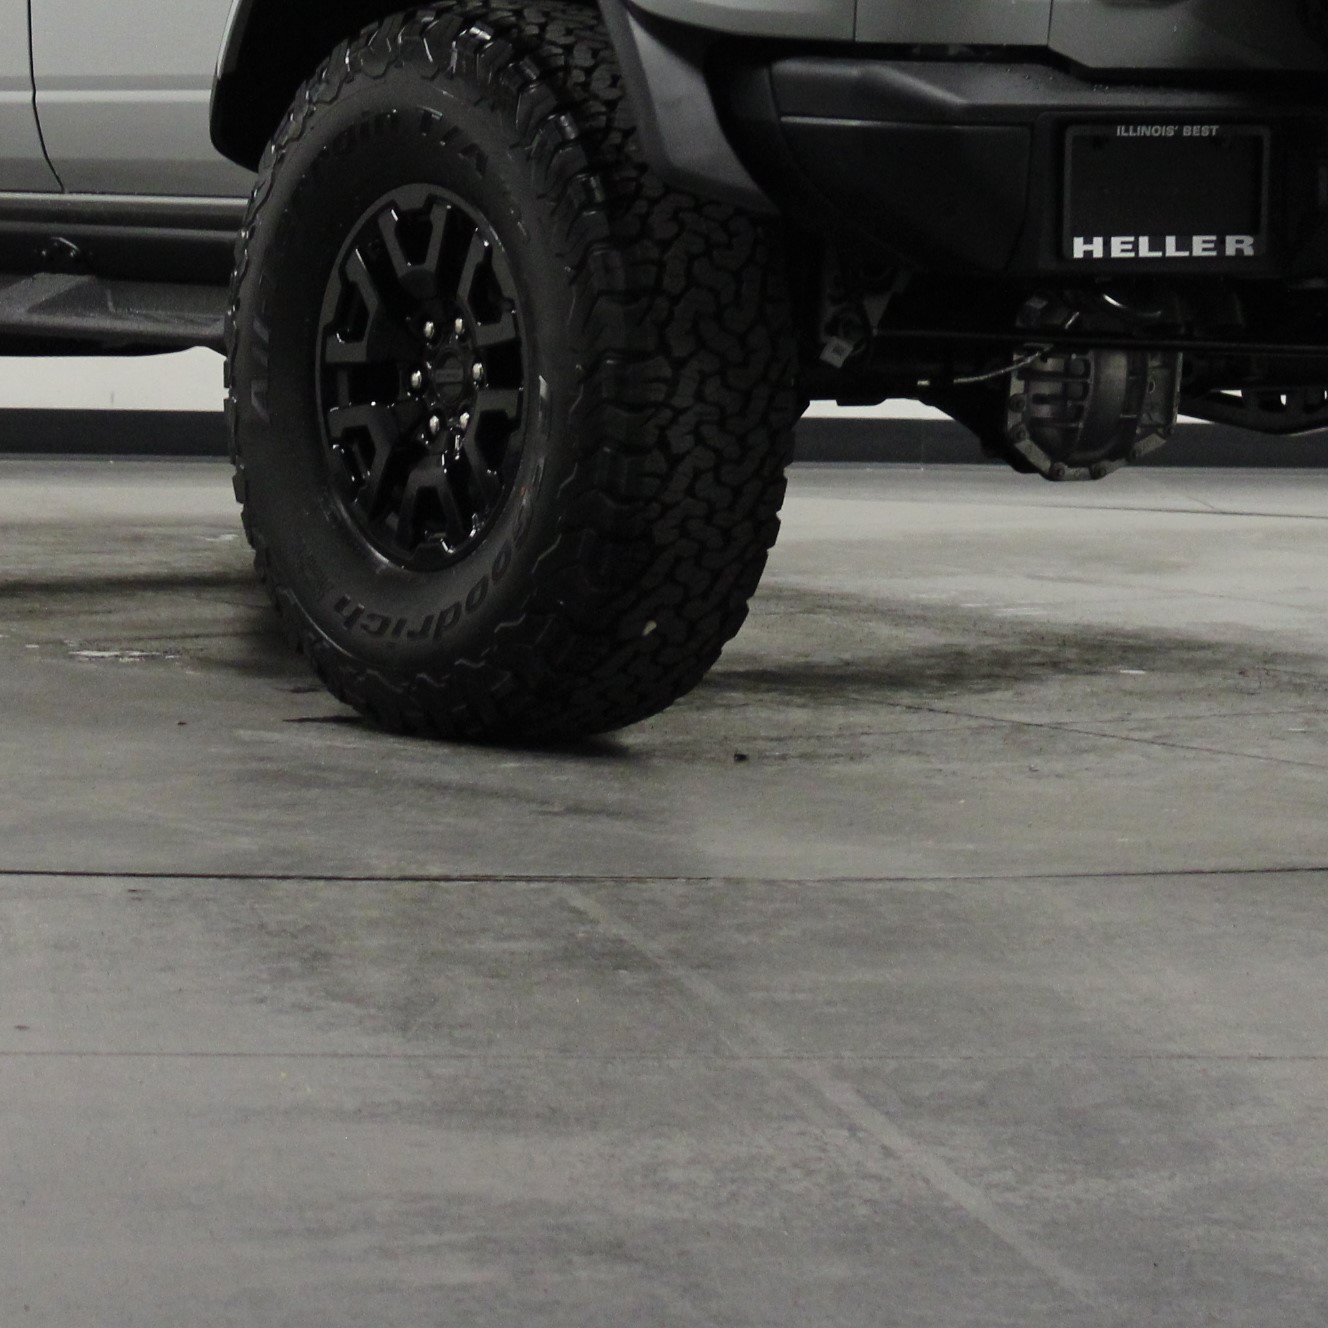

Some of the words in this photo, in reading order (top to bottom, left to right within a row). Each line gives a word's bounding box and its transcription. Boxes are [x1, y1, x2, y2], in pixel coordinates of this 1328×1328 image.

[1116, 124, 1179, 138] ILLINOIS'
[1182, 124, 1220, 138] BEST
[1072, 234, 1255, 260] HELLER
